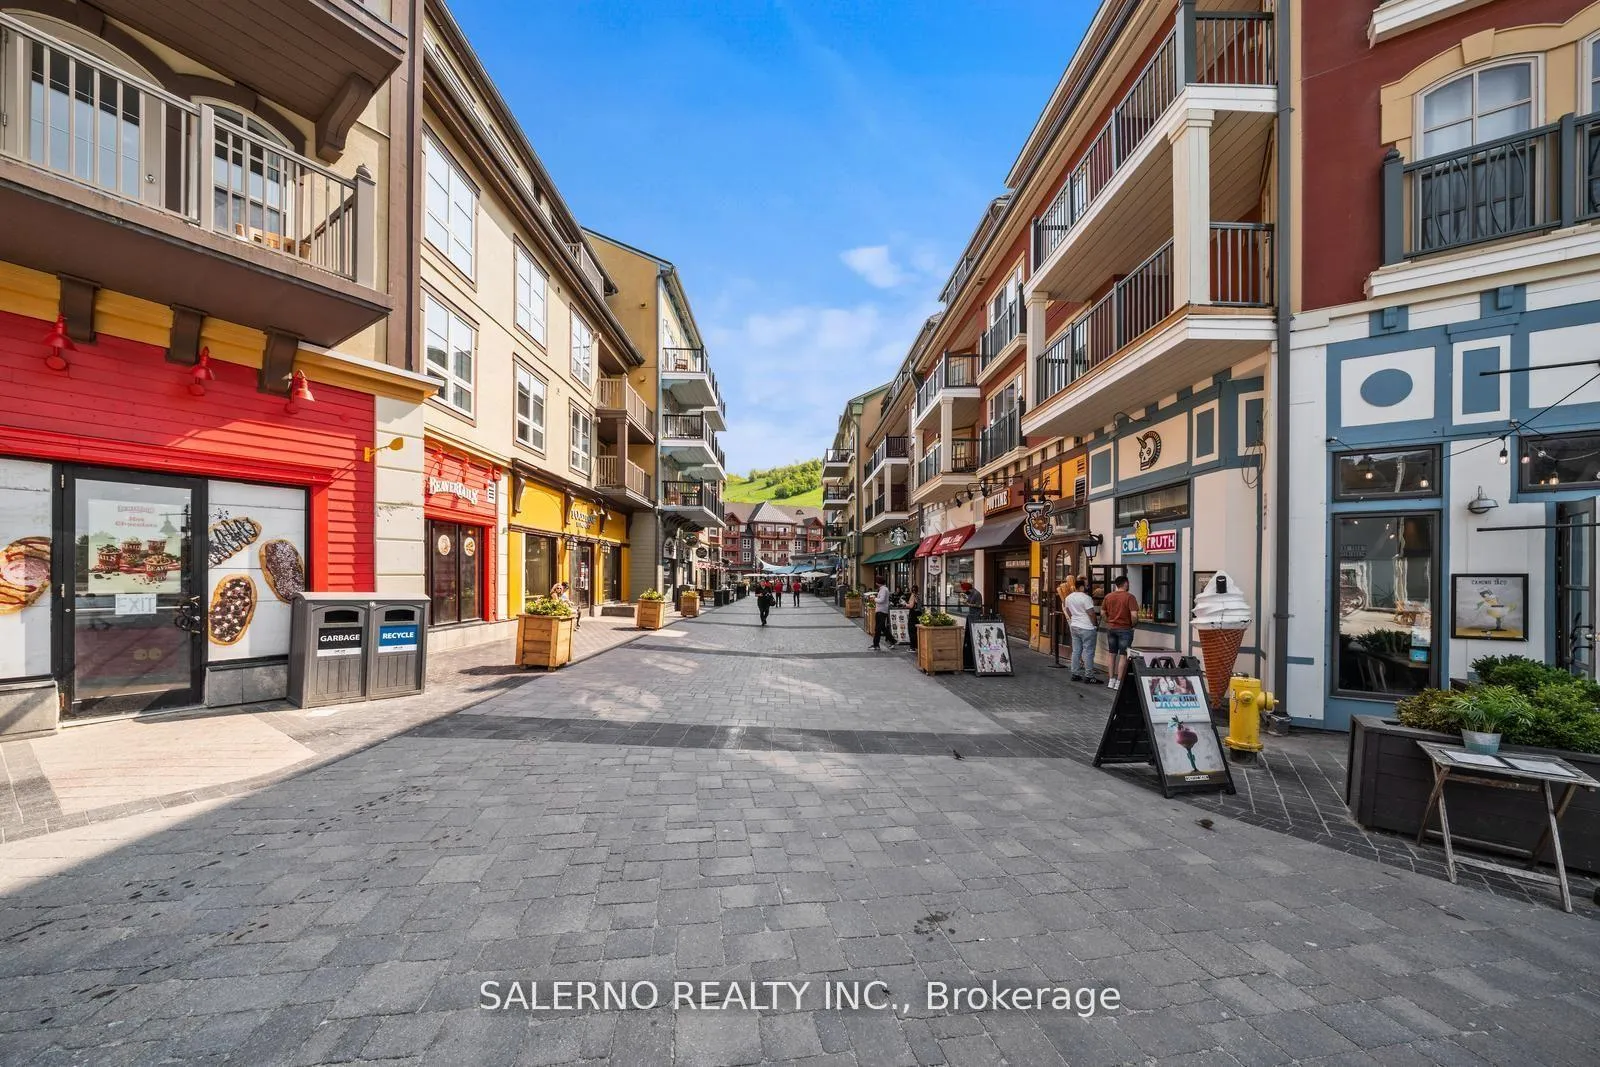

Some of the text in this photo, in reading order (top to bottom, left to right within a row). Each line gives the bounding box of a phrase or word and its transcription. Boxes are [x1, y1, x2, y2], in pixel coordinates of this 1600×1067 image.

[986, 490, 1008, 512] POUTINE
[1146, 533, 1175, 550] TRUTH
[116, 597, 157, 613] EXIT
[320, 633, 360, 642] GARBAGE
[382, 631, 415, 640] RECYCLE
